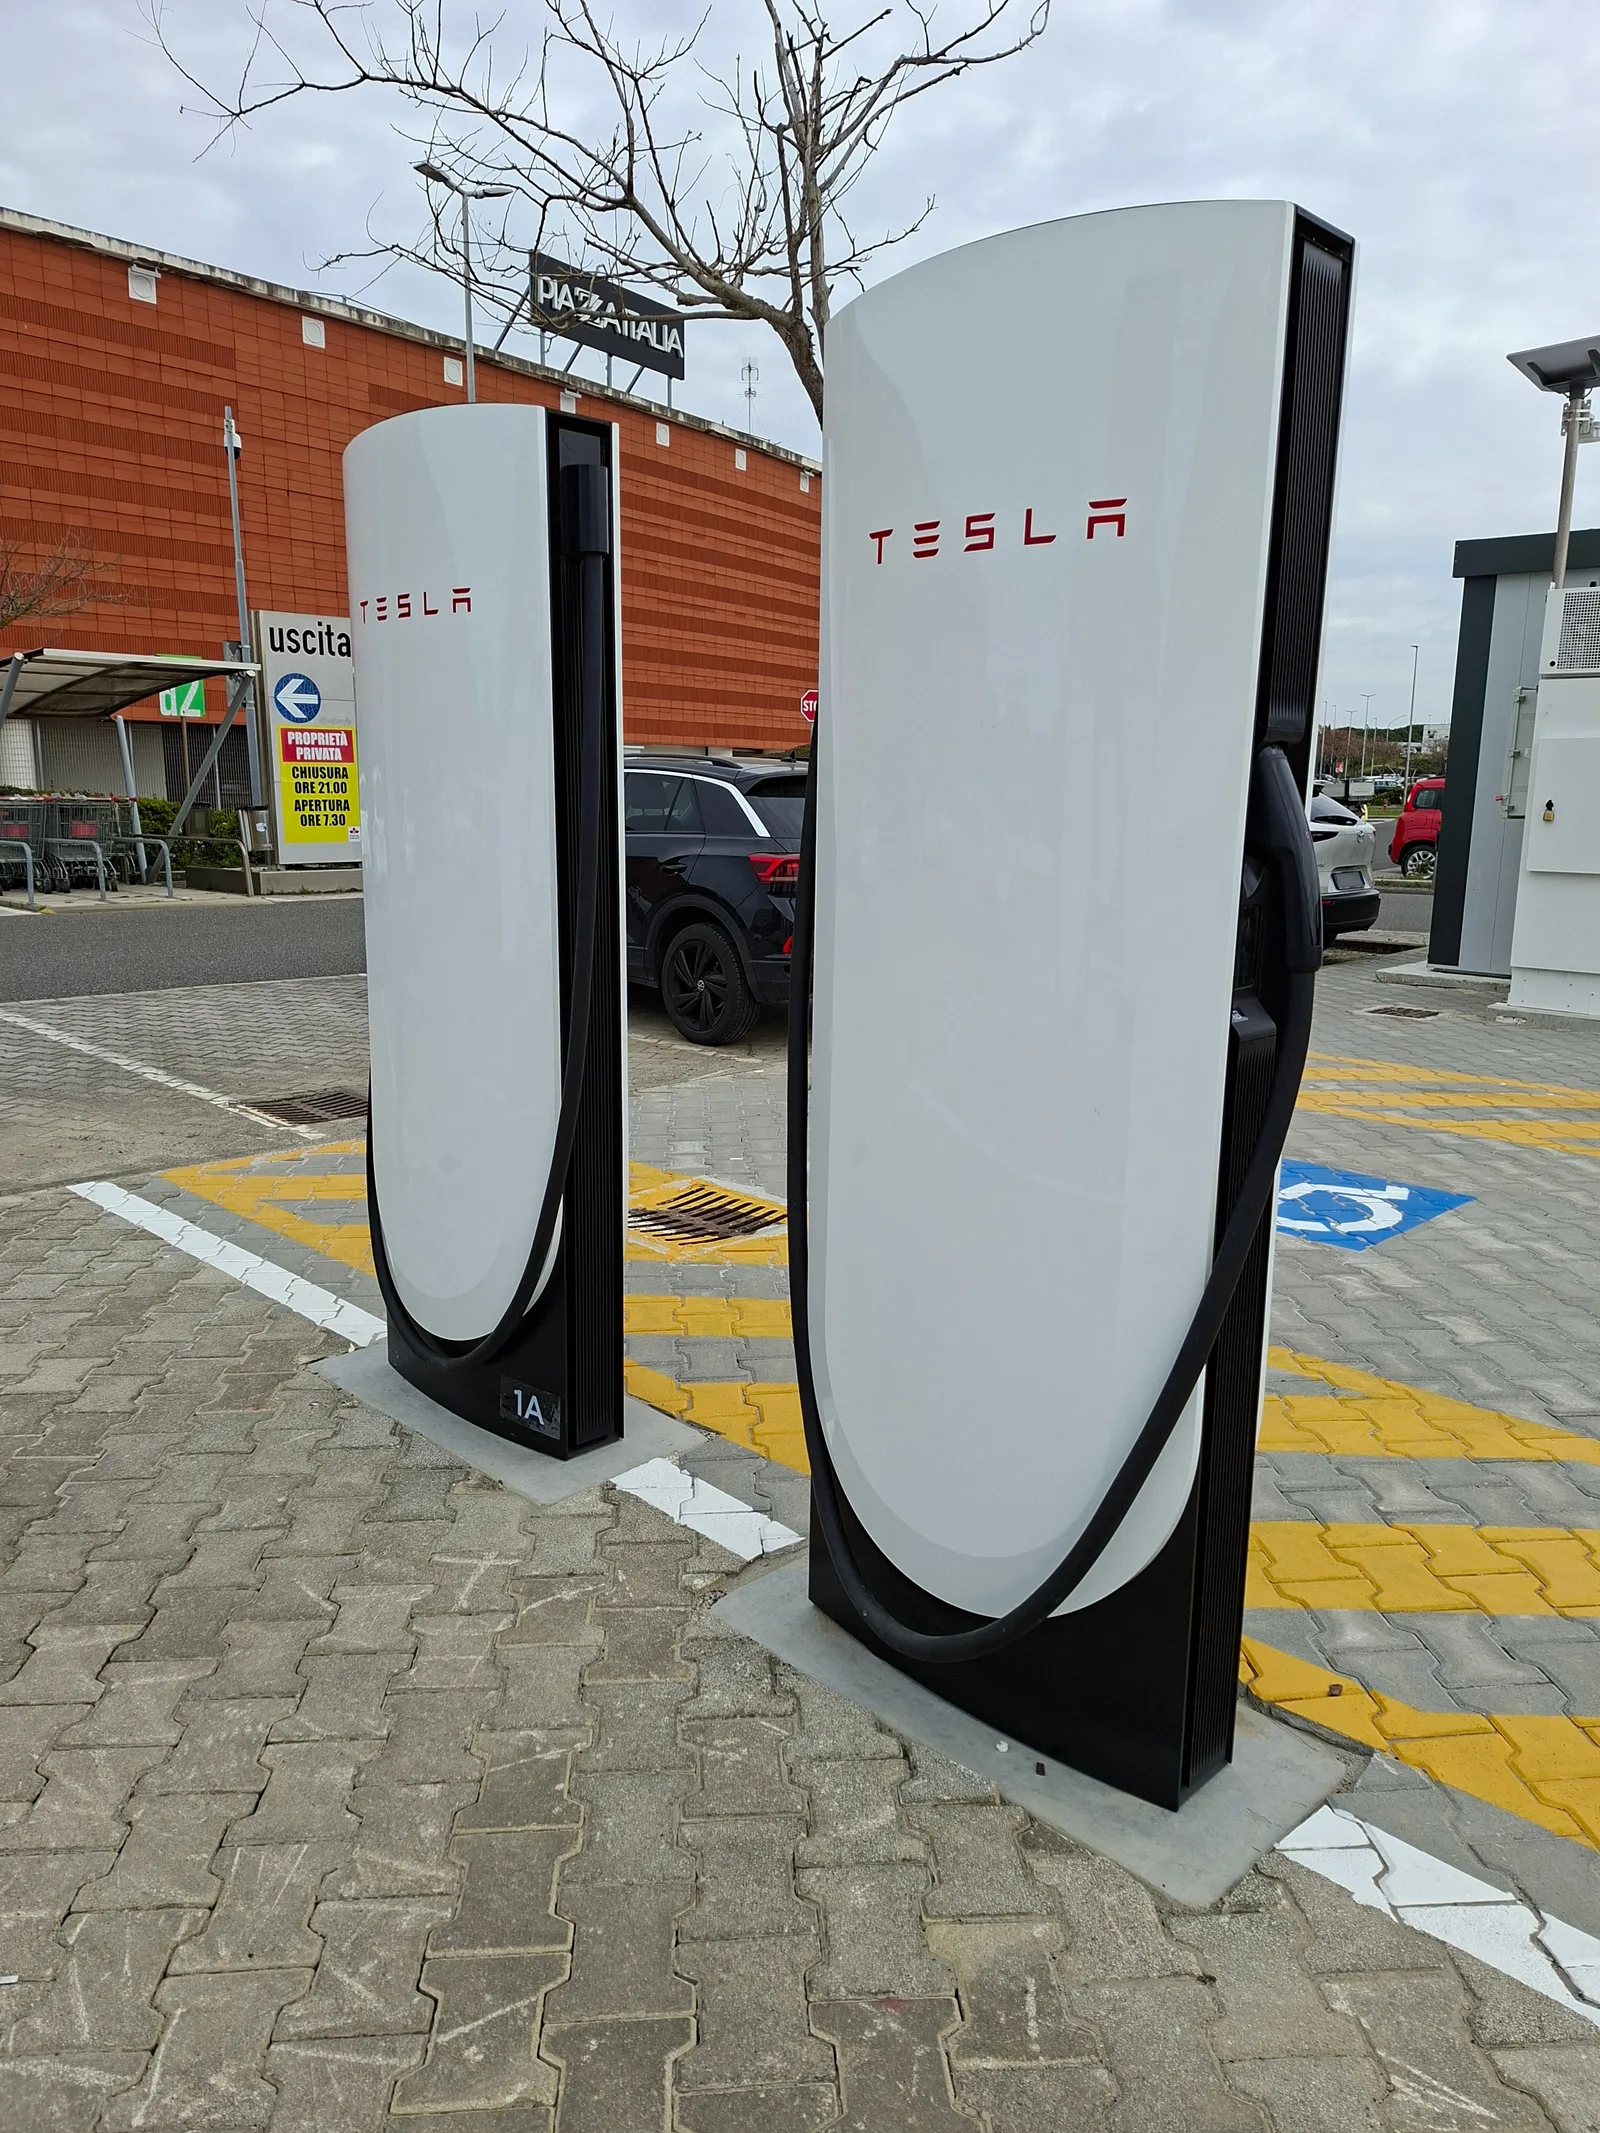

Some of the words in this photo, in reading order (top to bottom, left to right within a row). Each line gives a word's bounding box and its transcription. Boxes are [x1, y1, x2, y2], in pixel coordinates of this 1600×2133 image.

[869, 498, 1127, 565] TESLA
[360, 588, 471, 624] TESLA
[269, 621, 351, 658] uscita
[287, 730, 348, 747] PROPRIETÀ
[296, 747, 342, 761] PRIVATA
[292, 766, 348, 779] CHIUSURA
[295, 781, 315, 794] ORE
[318, 781, 347, 794] 21.00
[294, 799, 350, 812] APERTURA
[300, 814, 321, 827] ORE
[323, 814, 346, 827] 7.30
[514, 1389, 545, 1425] 1A
